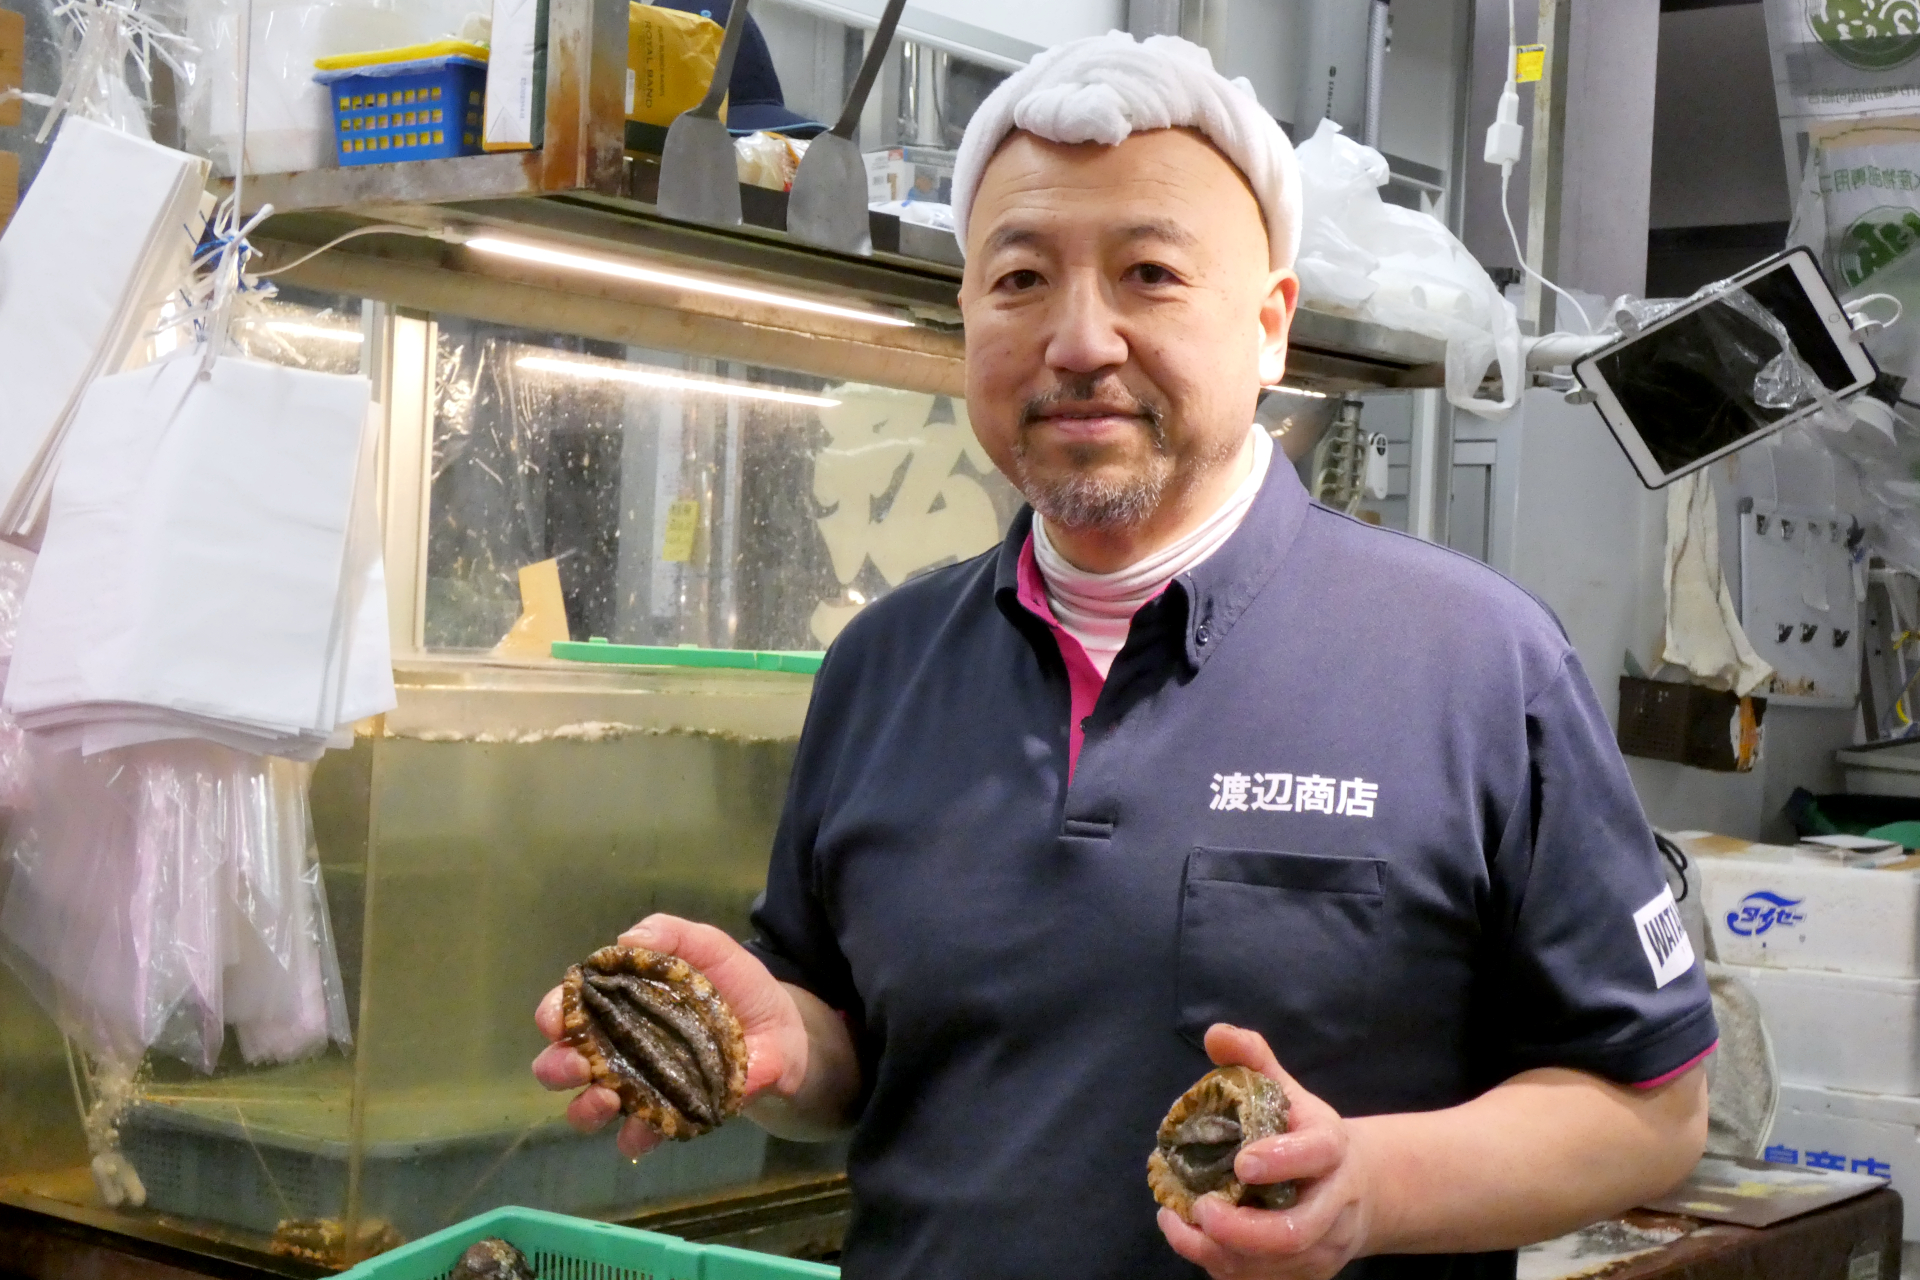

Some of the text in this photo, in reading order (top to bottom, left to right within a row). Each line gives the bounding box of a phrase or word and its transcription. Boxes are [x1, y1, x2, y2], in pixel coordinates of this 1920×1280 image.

[645, 20, 654, 109] ROYAL BAND
[1209, 772, 1379, 818] 渡辺商店
